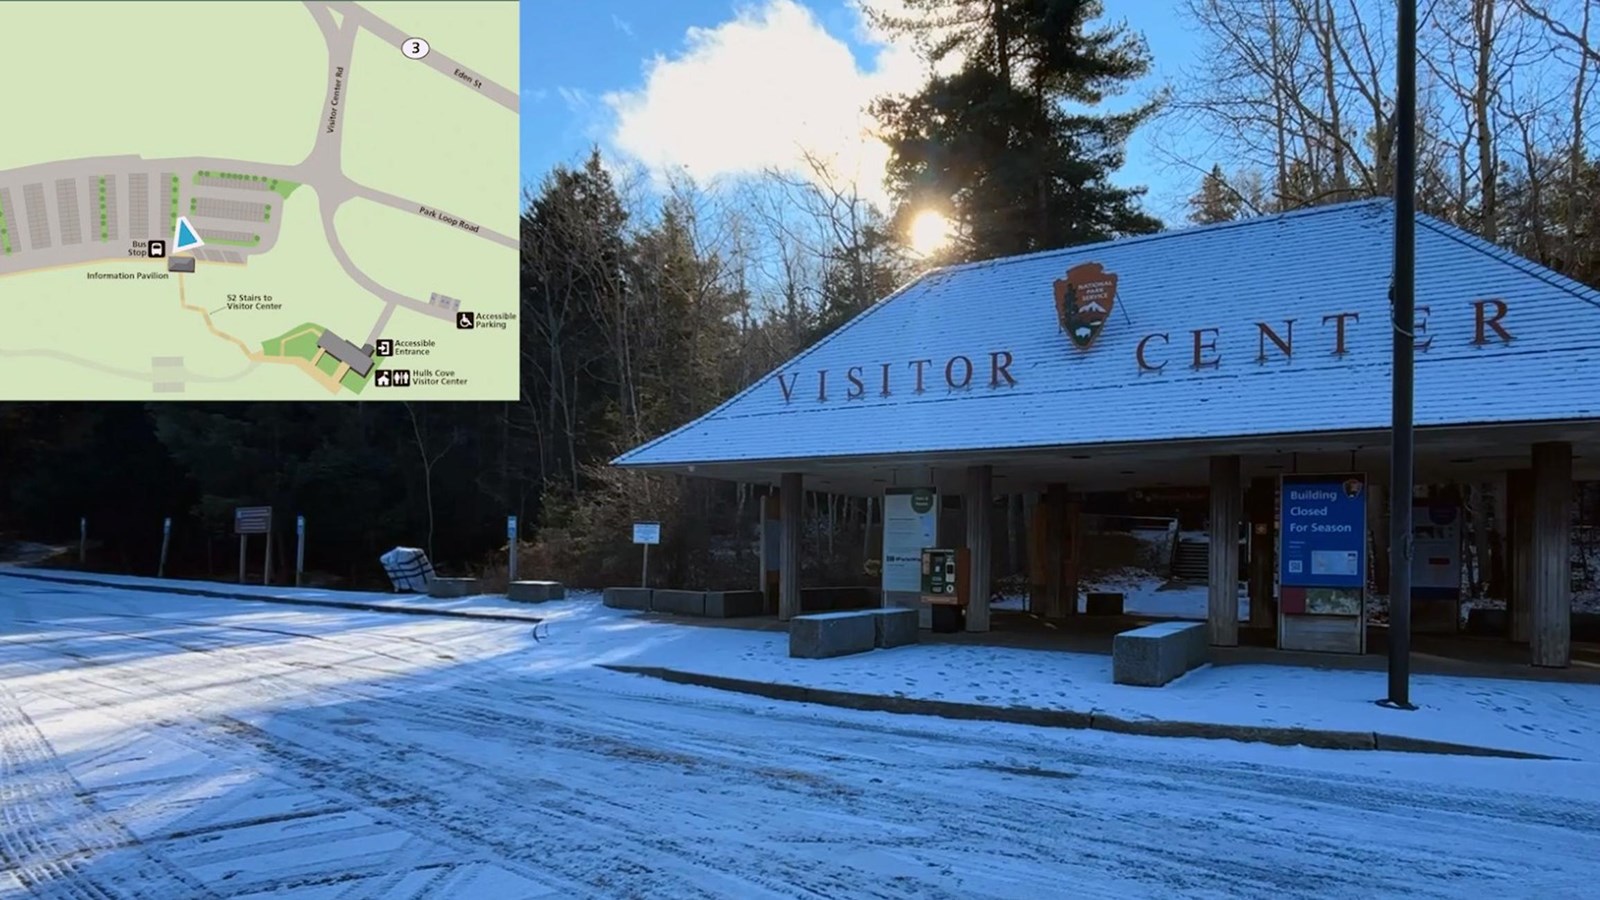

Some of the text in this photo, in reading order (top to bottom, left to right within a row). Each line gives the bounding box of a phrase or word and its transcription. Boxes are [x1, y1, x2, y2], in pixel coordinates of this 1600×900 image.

[1078, 281, 1113, 290] NATIONAL
[1082, 293, 1108, 301] SERVICE
[778, 351, 1018, 404] VISITOR
[1290, 491, 1337, 502] Building
[1290, 506, 1328, 516] Closed
[1290, 523, 1352, 533] For Season
